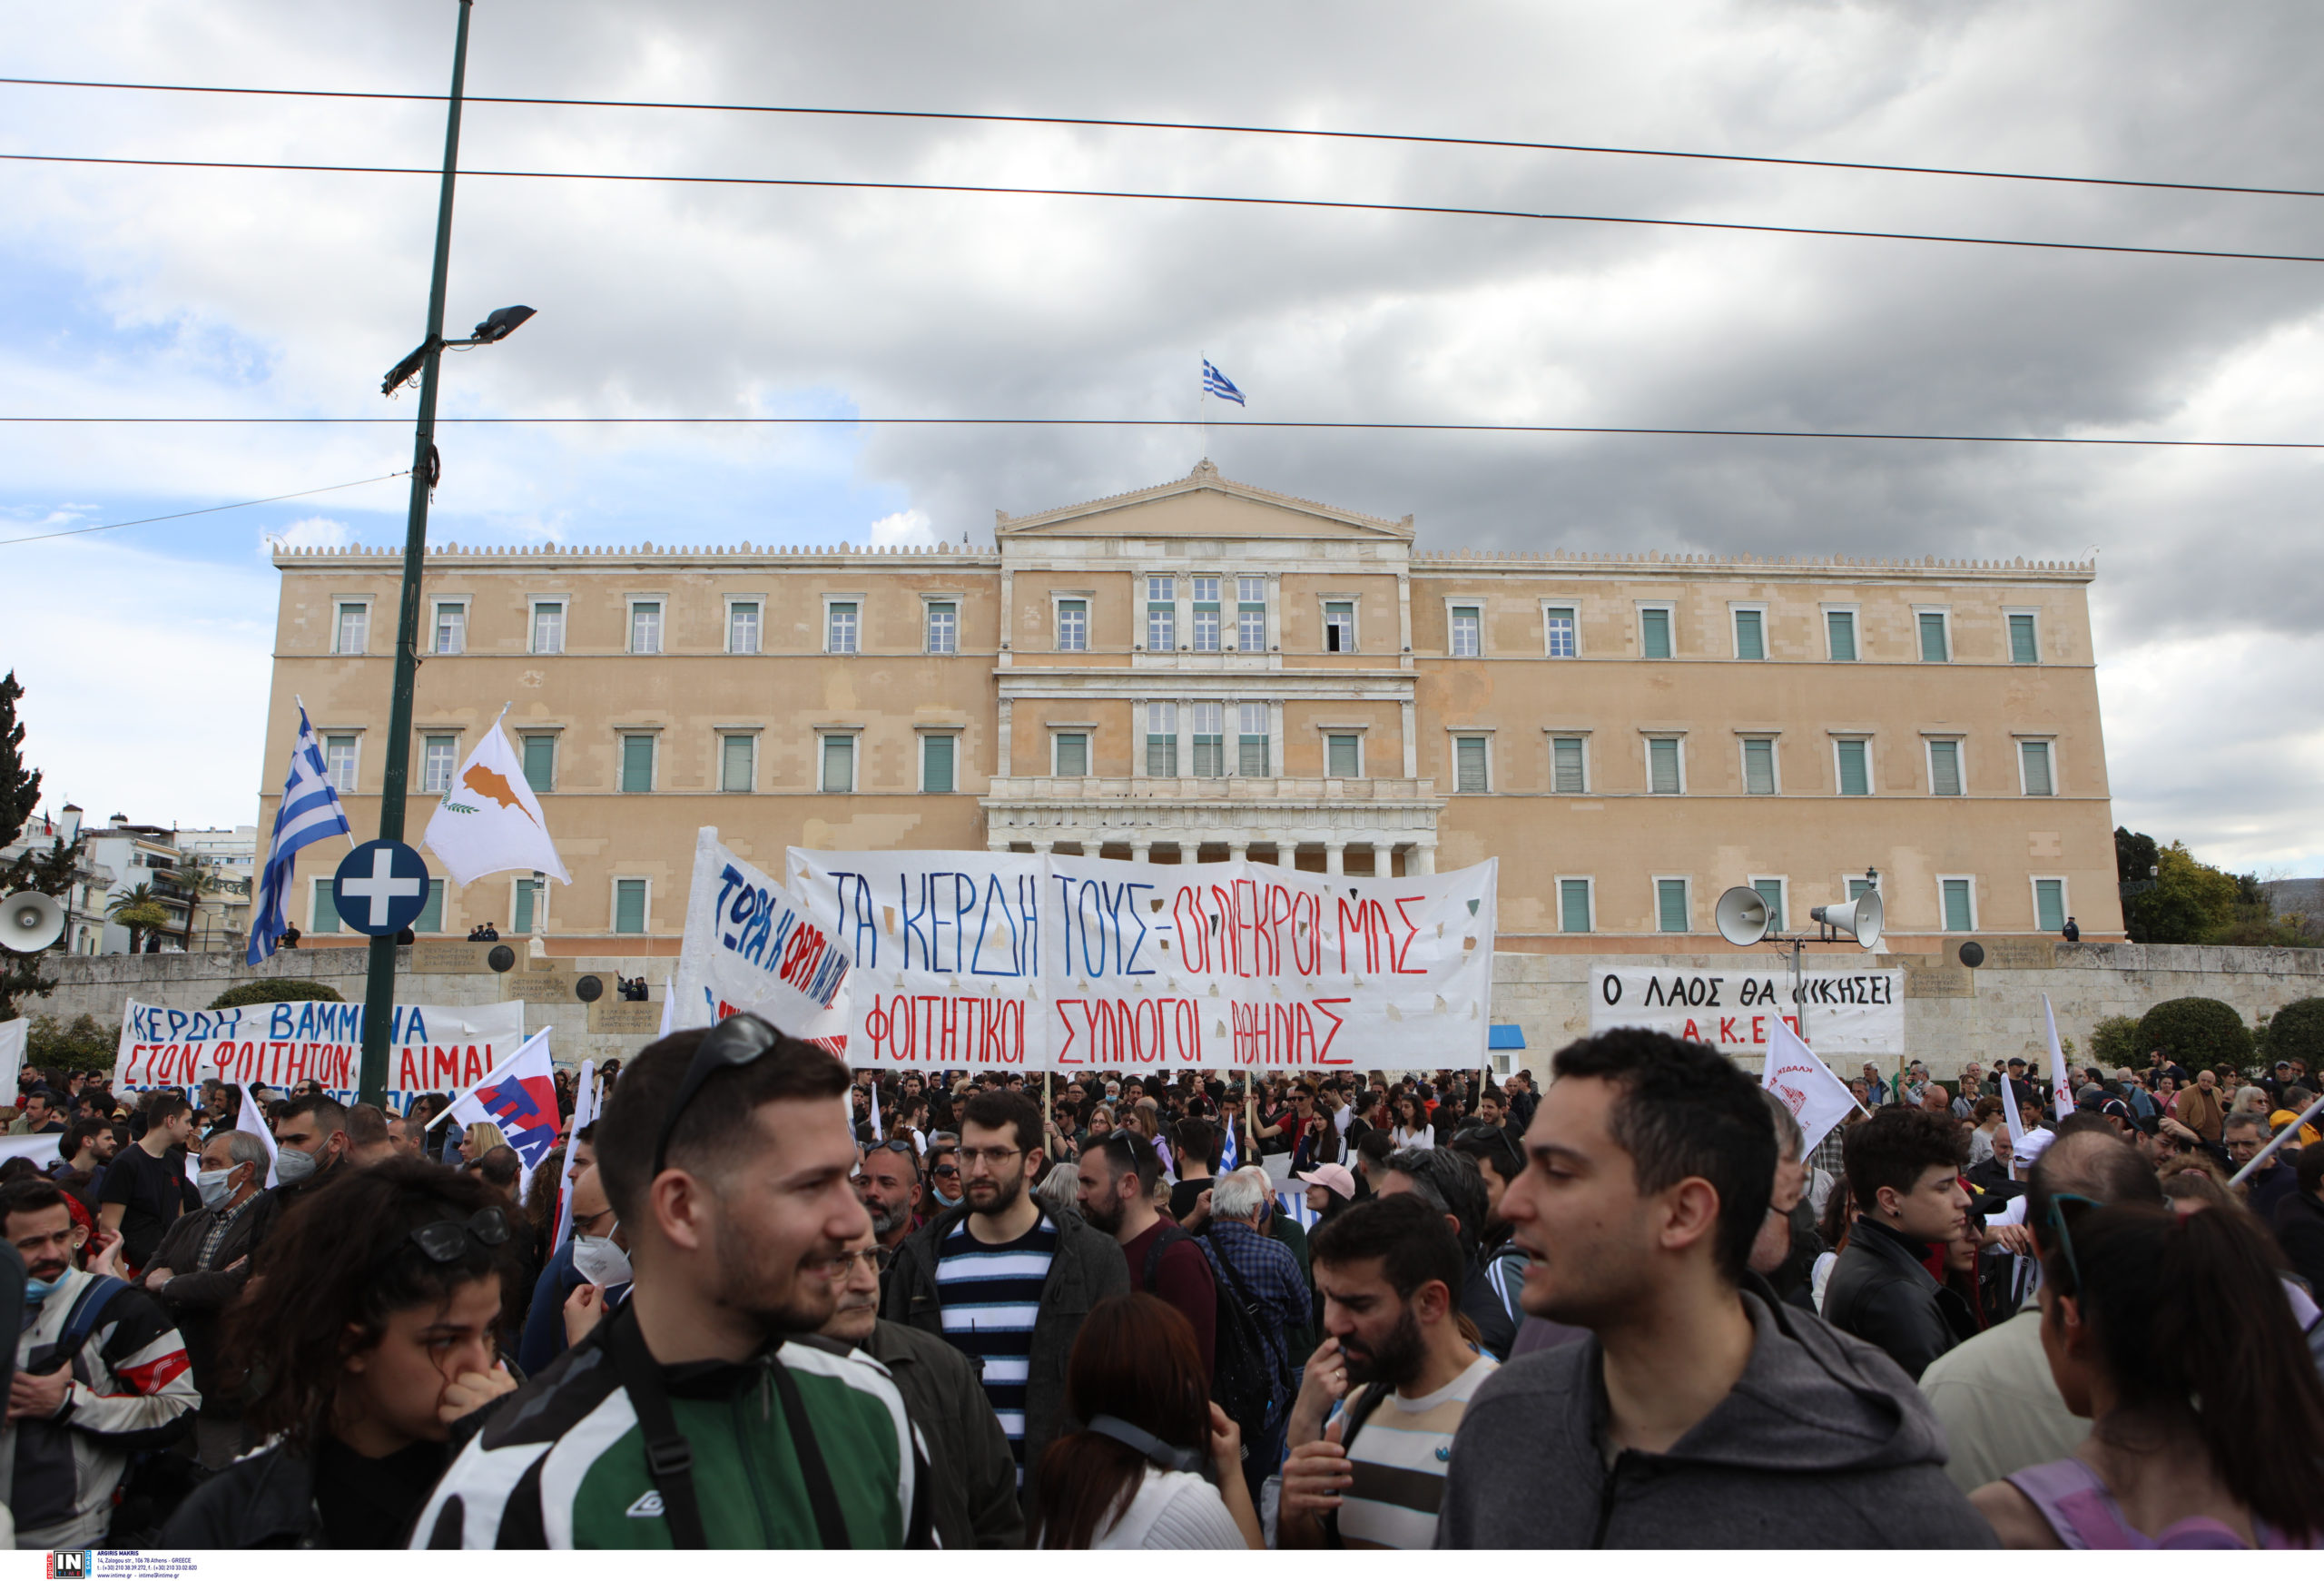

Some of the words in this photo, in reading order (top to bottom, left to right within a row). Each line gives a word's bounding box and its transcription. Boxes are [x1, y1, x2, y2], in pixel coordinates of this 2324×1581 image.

[828, 872, 876, 969] ΤΑ
[901, 872, 1038, 978] ΚΕΡΔΗ
[1212, 879, 1321, 978] ΝΕΚΡΟΙ
[1603, 973, 1622, 1006] Ο
[1644, 976, 1724, 1006] ΛΑΟΣ
[1739, 977, 1777, 1006] ΘΑ
[133, 1004, 241, 1042] ΚΕΡΔΗ
[270, 1002, 428, 1044] ΒΑΜΜΑ
[865, 993, 1025, 1064] ΦΟΙΤΗΤΙΚΟΙ
[1056, 997, 1202, 1064] ΣΥΛΛΟΓΟΙ
[1231, 997, 1354, 1064] ΑΘΗΝΑΣ
